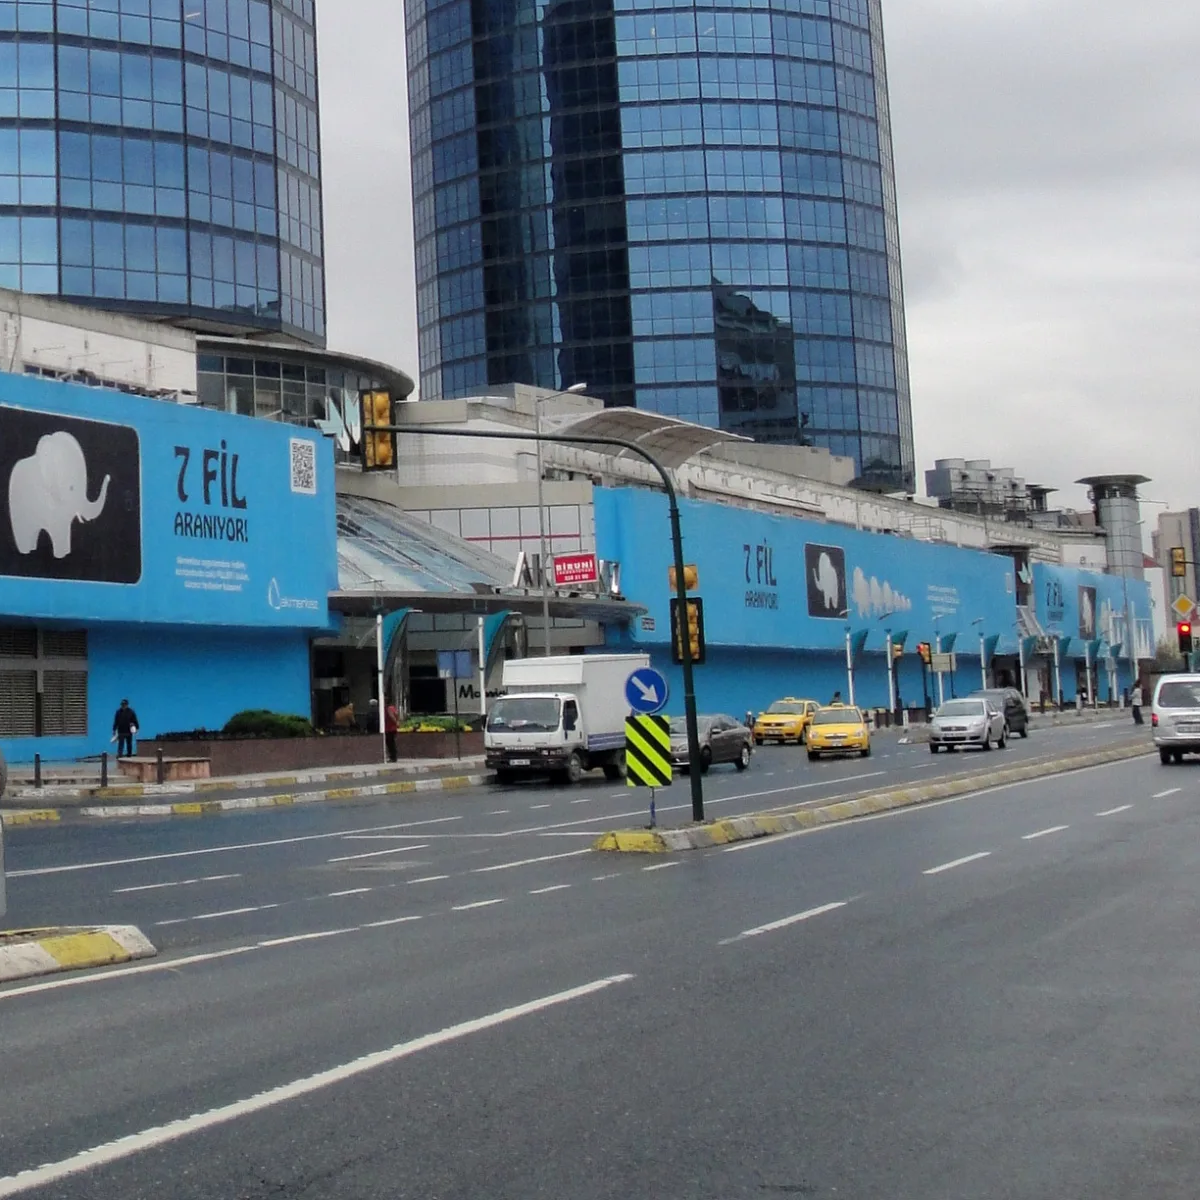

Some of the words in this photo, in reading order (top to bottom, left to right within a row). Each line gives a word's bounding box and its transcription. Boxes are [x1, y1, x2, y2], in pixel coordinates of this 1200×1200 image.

[174, 445, 190, 503] 7
[203, 439, 247, 510] FİL
[174, 511, 248, 543] ARANIYOR!
[743, 543, 751, 584] 7
[756, 537, 777, 587] FİL
